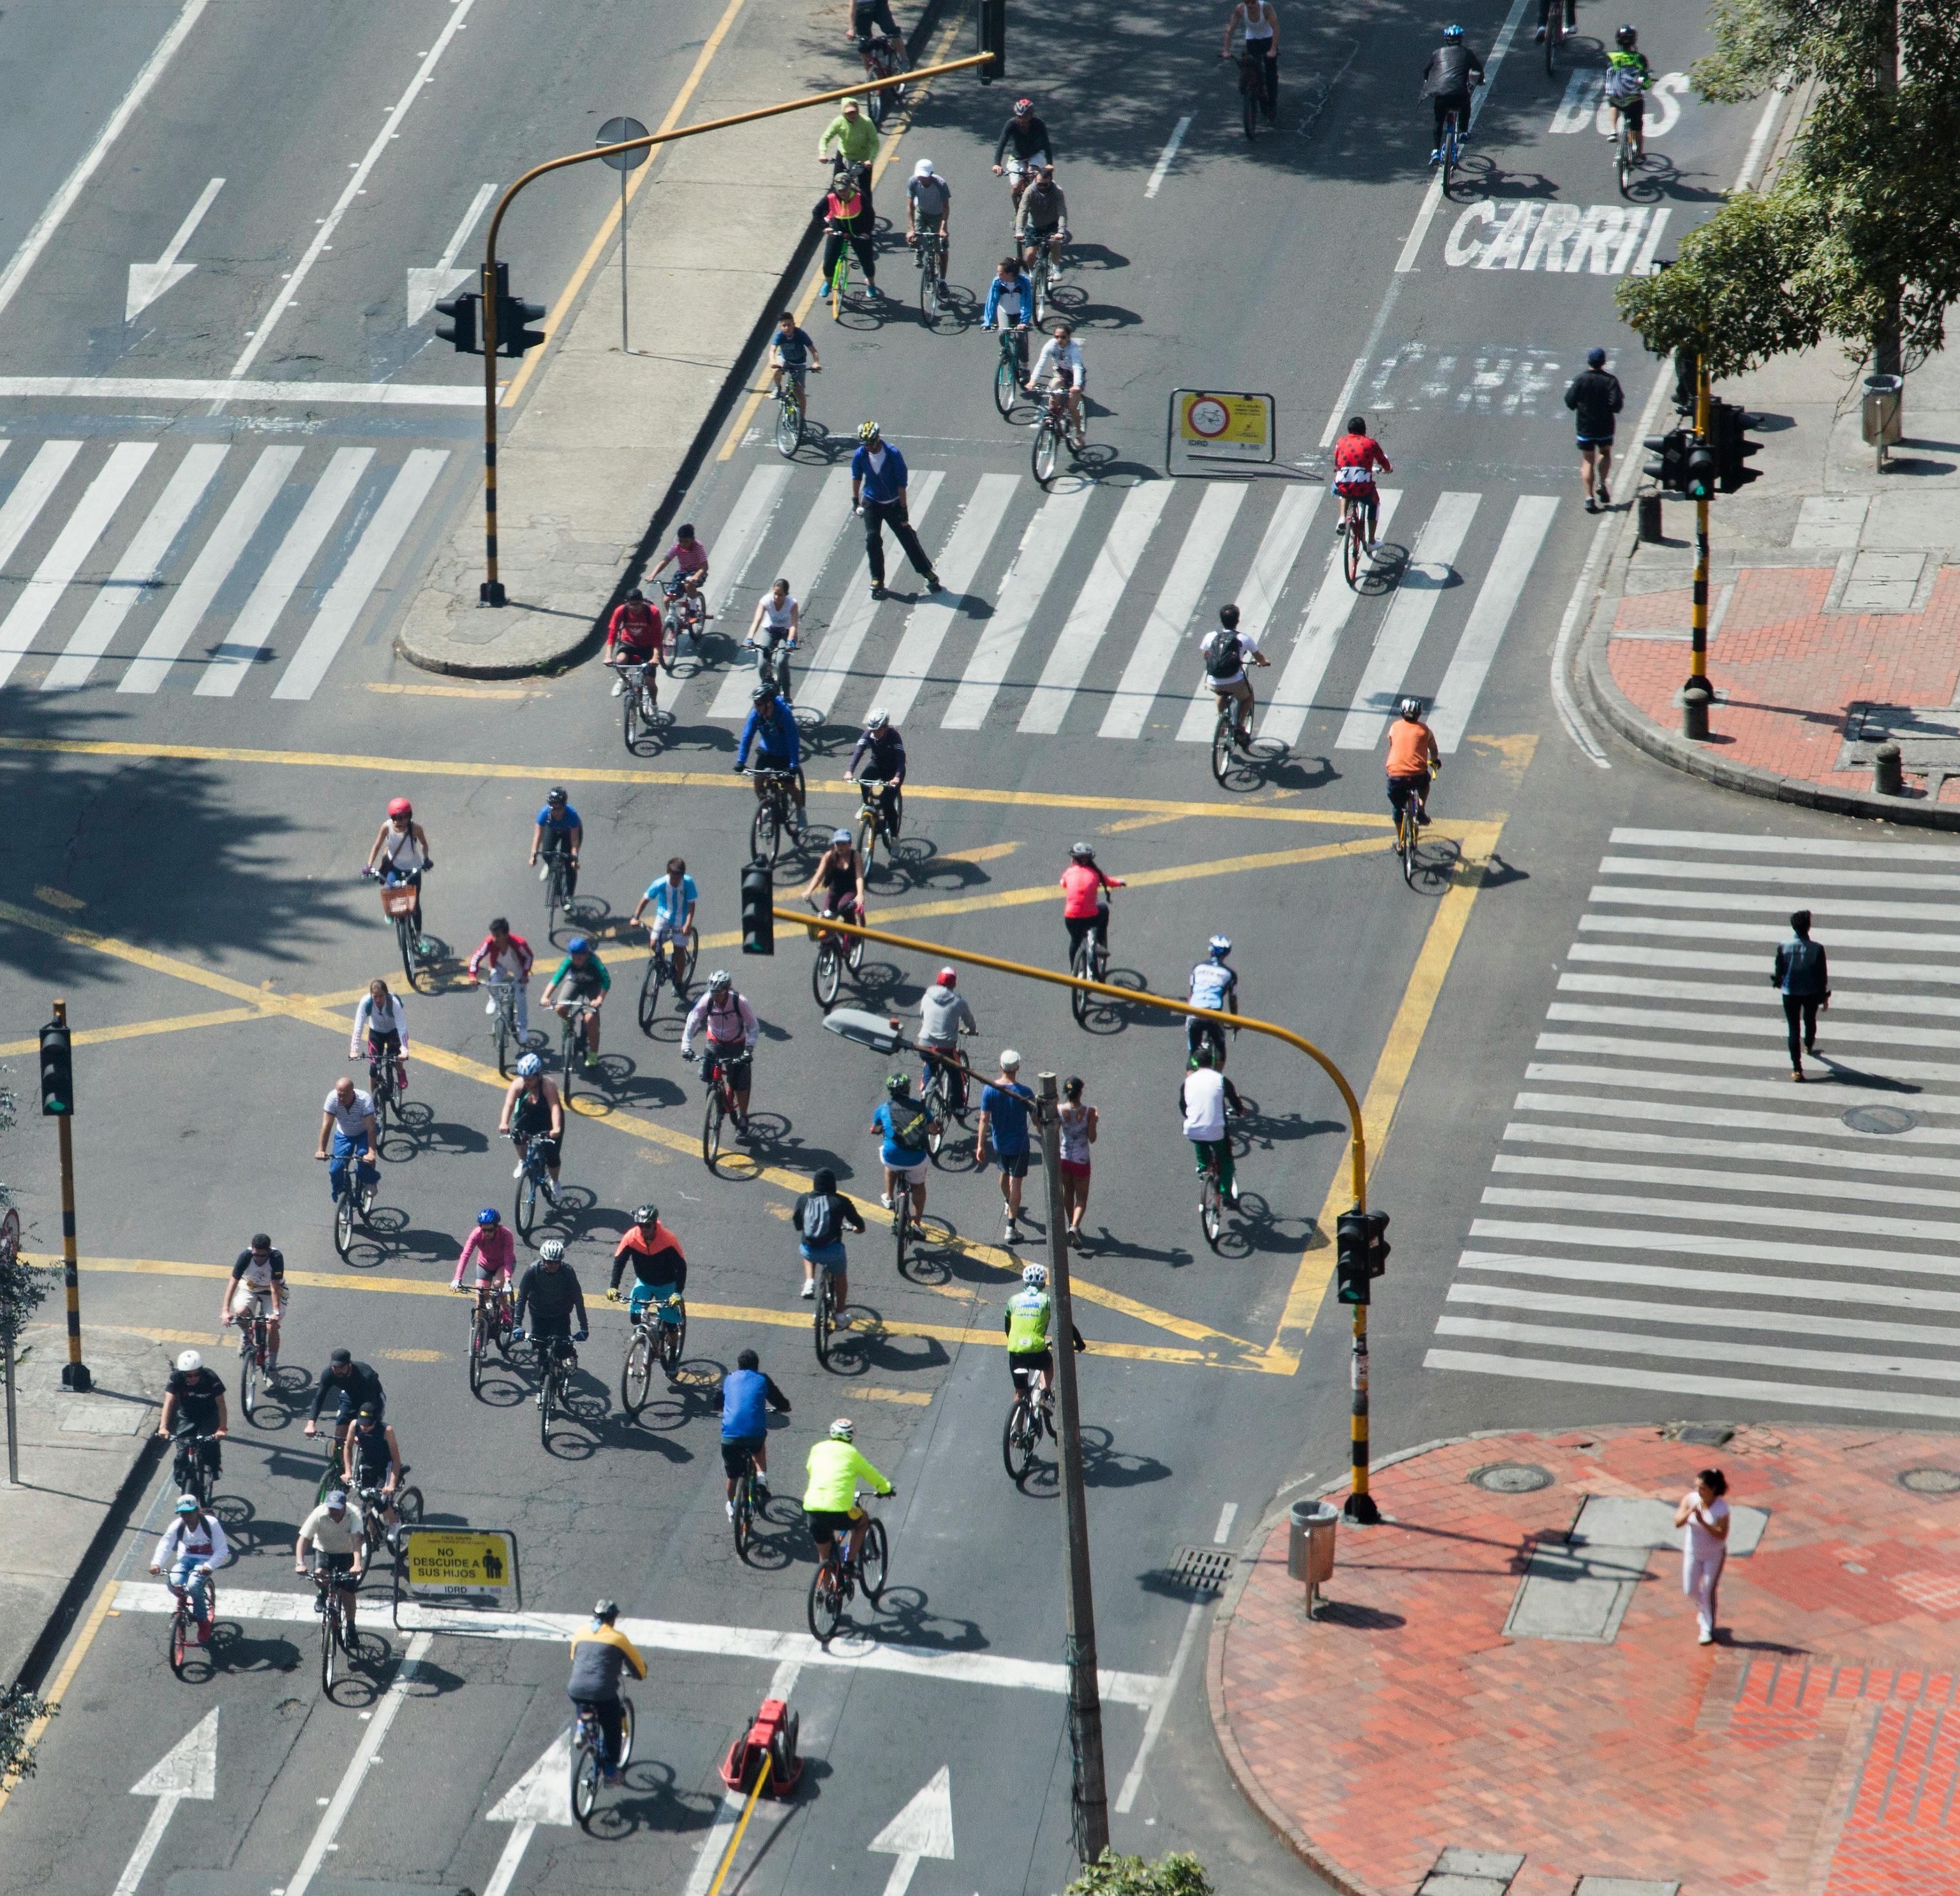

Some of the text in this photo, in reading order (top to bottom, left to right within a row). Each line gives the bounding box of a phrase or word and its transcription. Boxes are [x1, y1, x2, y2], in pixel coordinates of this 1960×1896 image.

[1444, 200, 1672, 276] CARRIL
[437, 1548, 454, 1556] NO
[413, 1558, 469, 1567] DESCUIDE
[419, 1569, 475, 1578] SUS HIJOS
